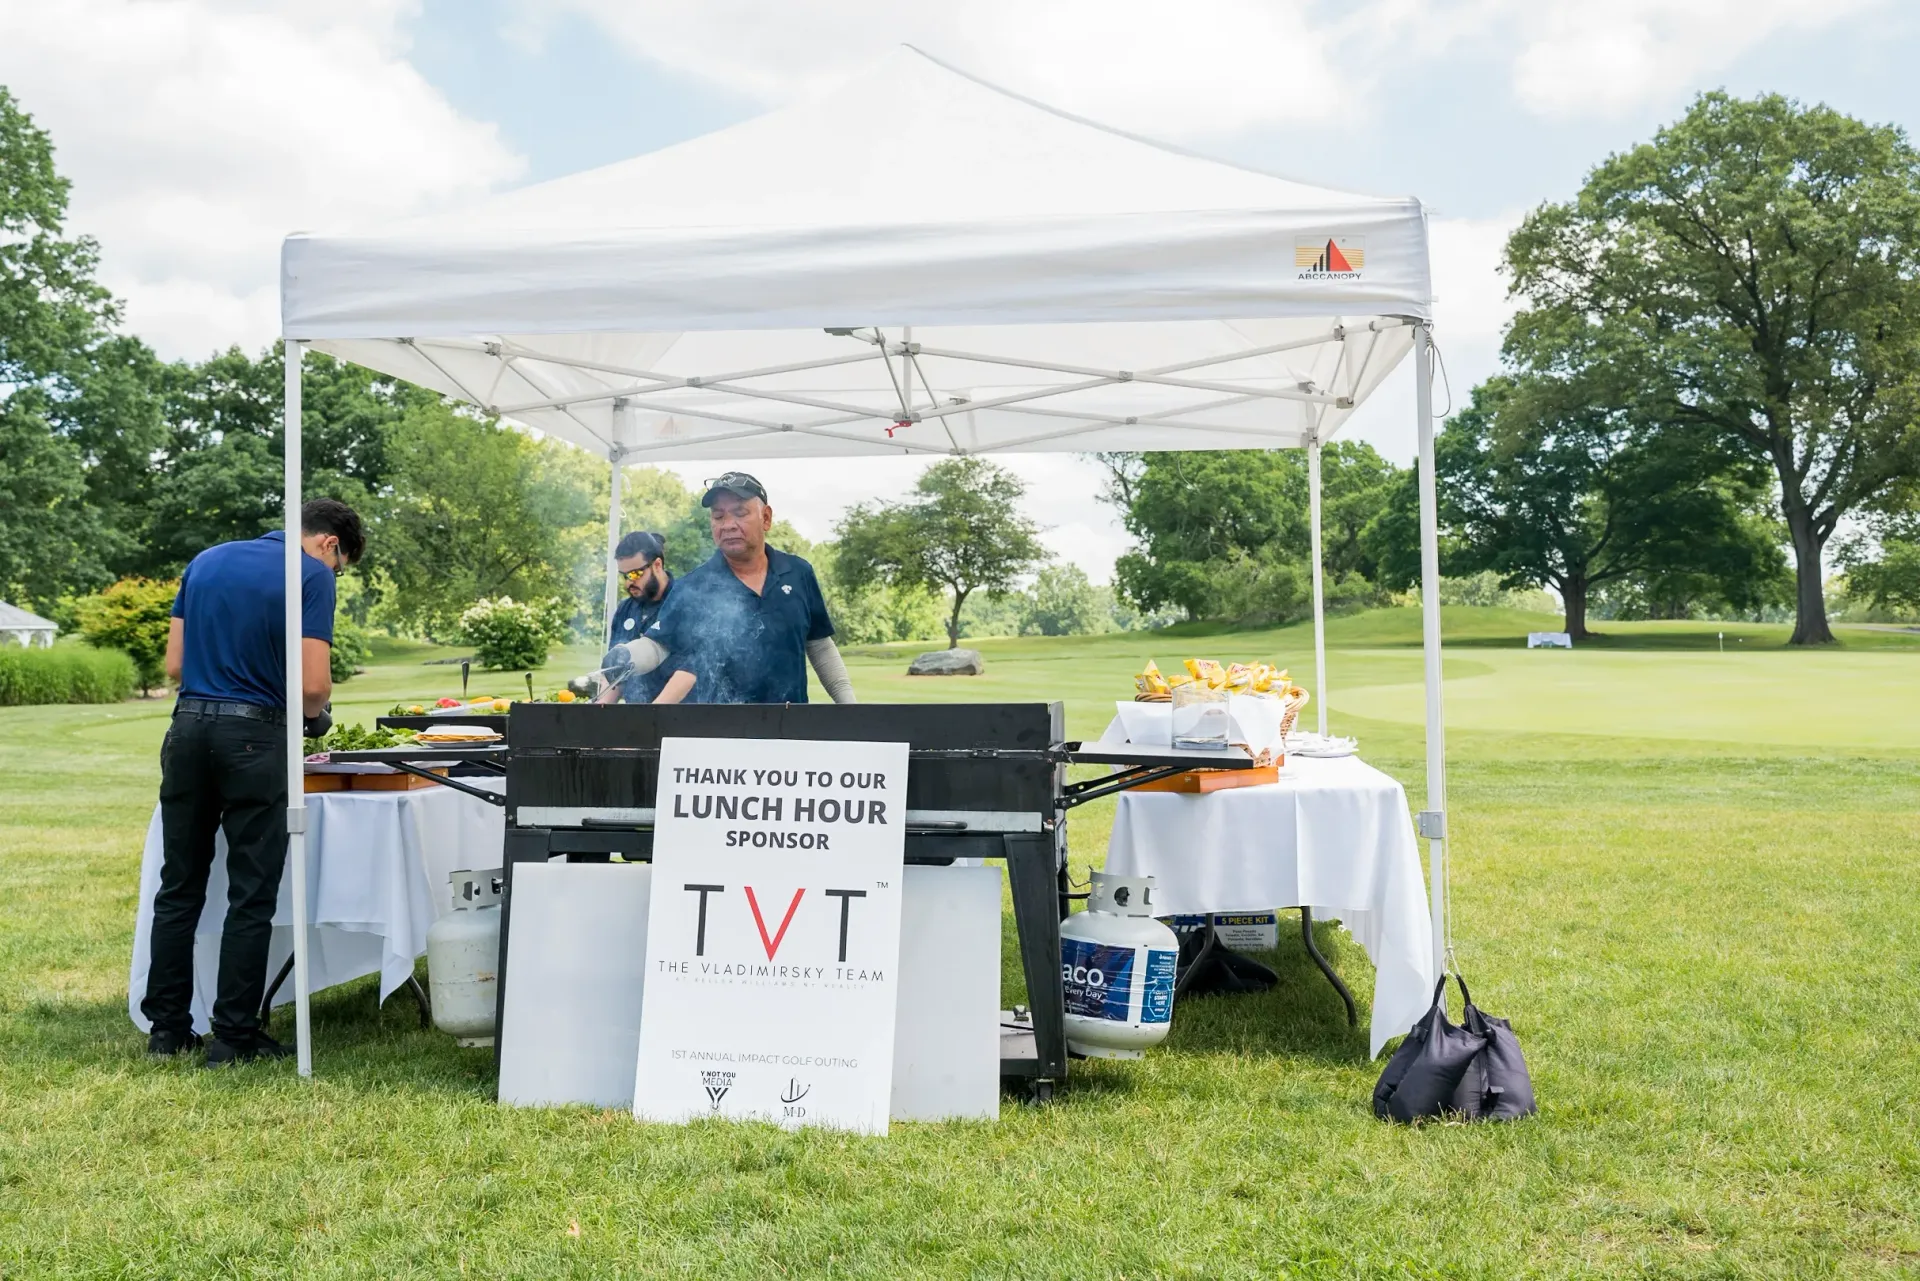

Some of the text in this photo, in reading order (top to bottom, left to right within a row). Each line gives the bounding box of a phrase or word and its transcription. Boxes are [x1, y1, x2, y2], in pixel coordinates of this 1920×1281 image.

[673, 767, 887, 790] THANK YOU TO OUR
[673, 794, 888, 825] LUNCH HOUR
[725, 830, 830, 850] SPONSOR
[683, 883, 867, 962] TVT
[1221, 916, 1269, 925] 5 PIECE KIT
[658, 960, 884, 982] THE VLADIMIRSKY TEAM
[1062, 964, 1108, 988] aco.
[671, 1049, 858, 1069] 1ST ANNUAL IMPACT GOLF OUTING
[702, 1077, 733, 1087] MEDIA
